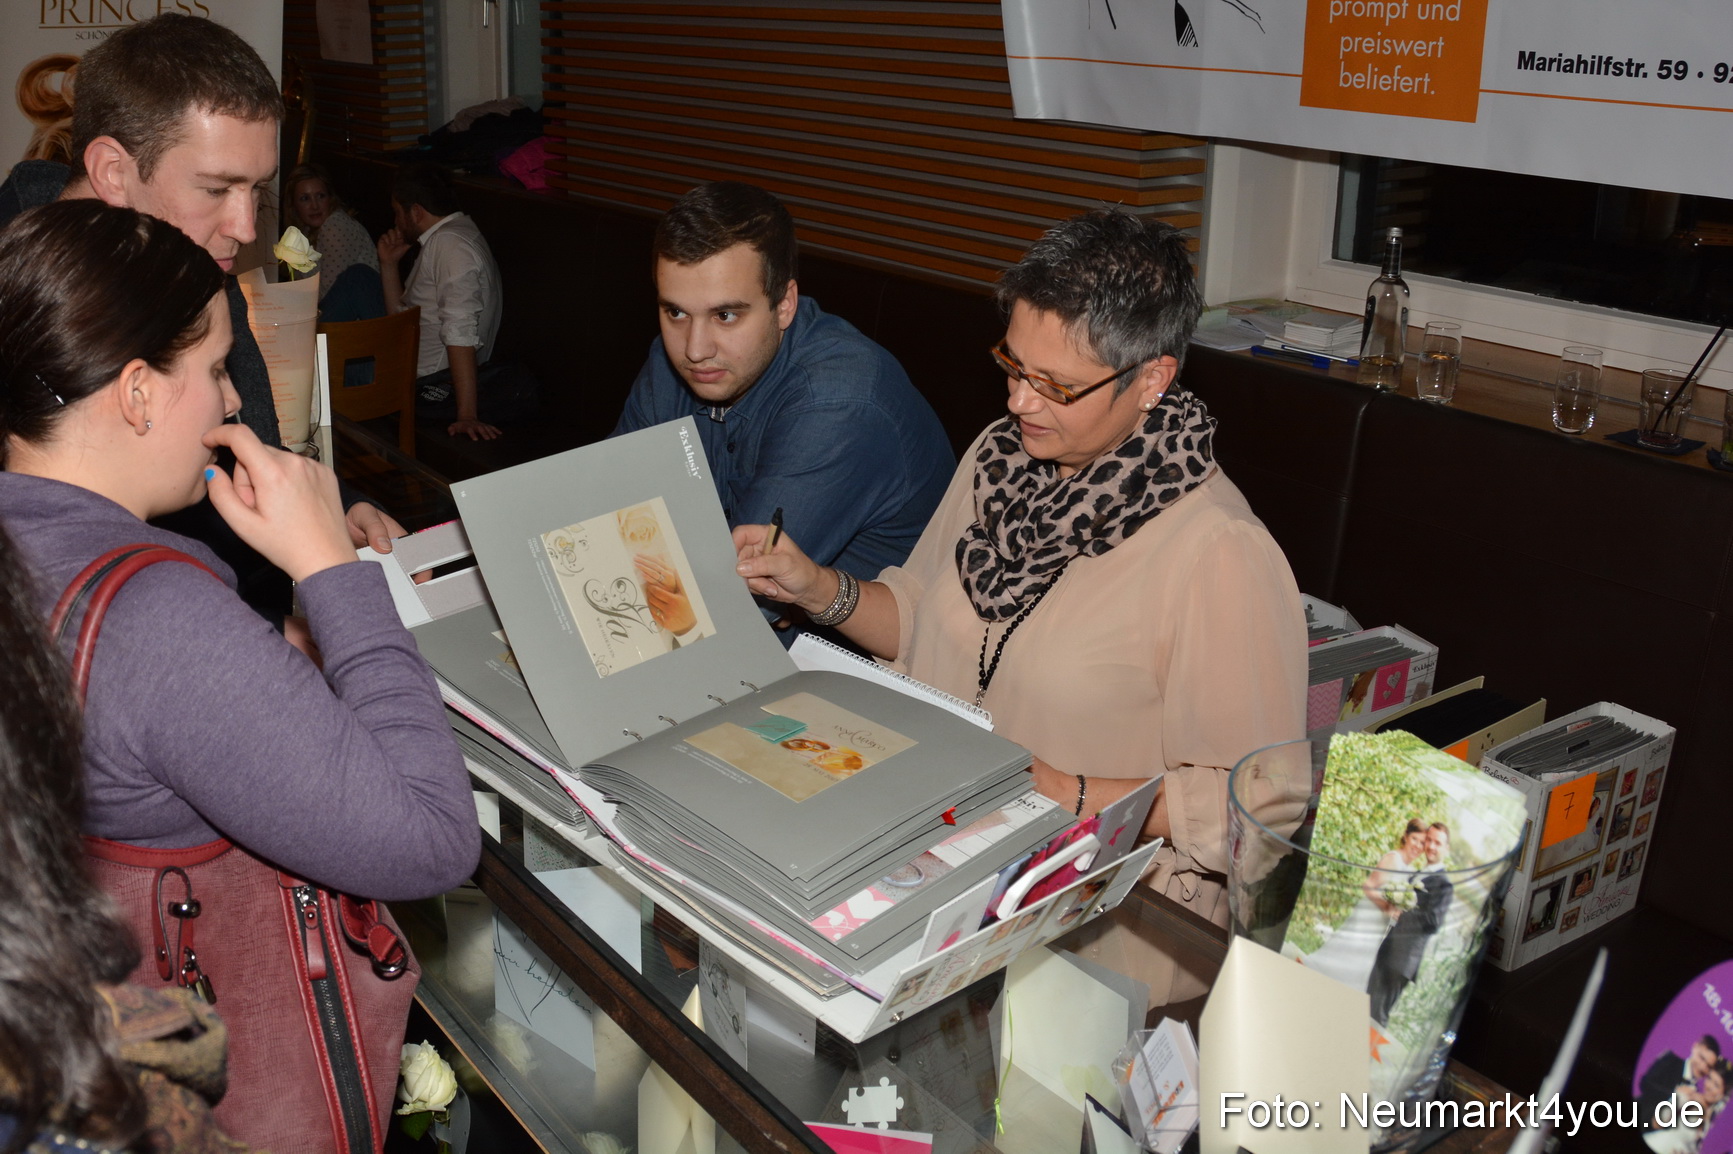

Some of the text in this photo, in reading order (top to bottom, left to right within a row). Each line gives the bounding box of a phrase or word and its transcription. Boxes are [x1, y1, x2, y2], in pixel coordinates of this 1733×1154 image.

[39, 0, 210, 24] PRINCESS
[1329, 0, 1462, 26] prompt und
[1340, 31, 1444, 59] preiswert
[1339, 61, 1435, 95] beliefert.
[1517, 50, 1648, 78] Mariahilfstr.
[1656, 59, 1689, 81] 59
[1563, 791, 1575, 820] 7
